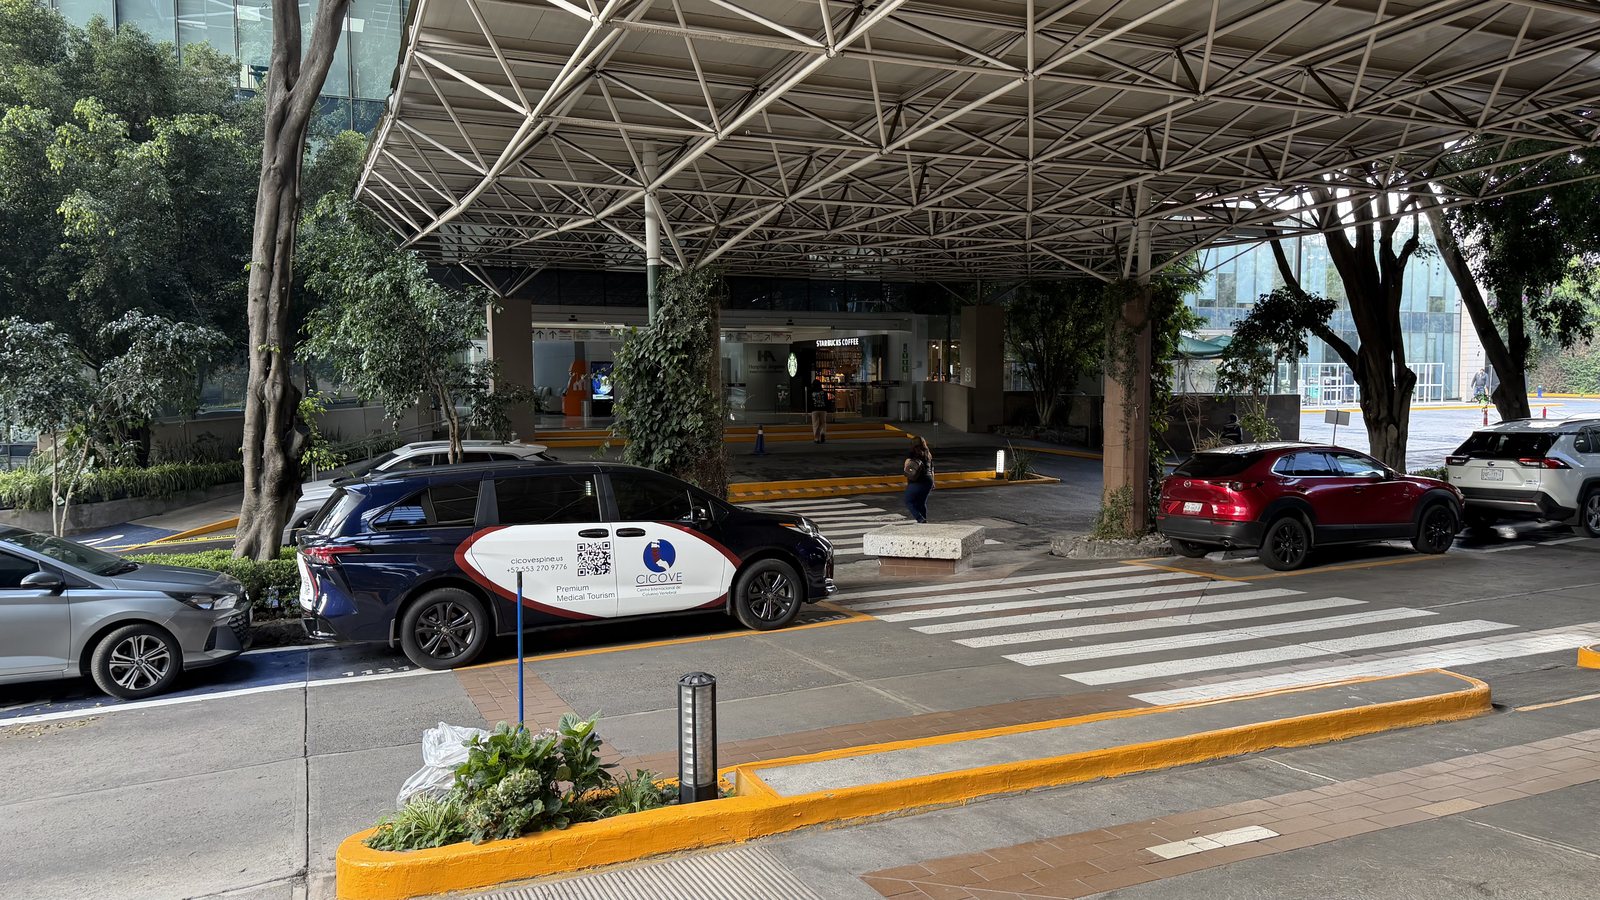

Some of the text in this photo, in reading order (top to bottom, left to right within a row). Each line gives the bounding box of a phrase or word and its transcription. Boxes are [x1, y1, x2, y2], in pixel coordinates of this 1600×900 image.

[816, 338, 859, 347] STARBUCKS COFFEE
[510, 556, 563, 564] cicovespine.us
[636, 572, 682, 584] CICOVE
[556, 585, 590, 593] Premium
[556, 593, 585, 601] Medical
